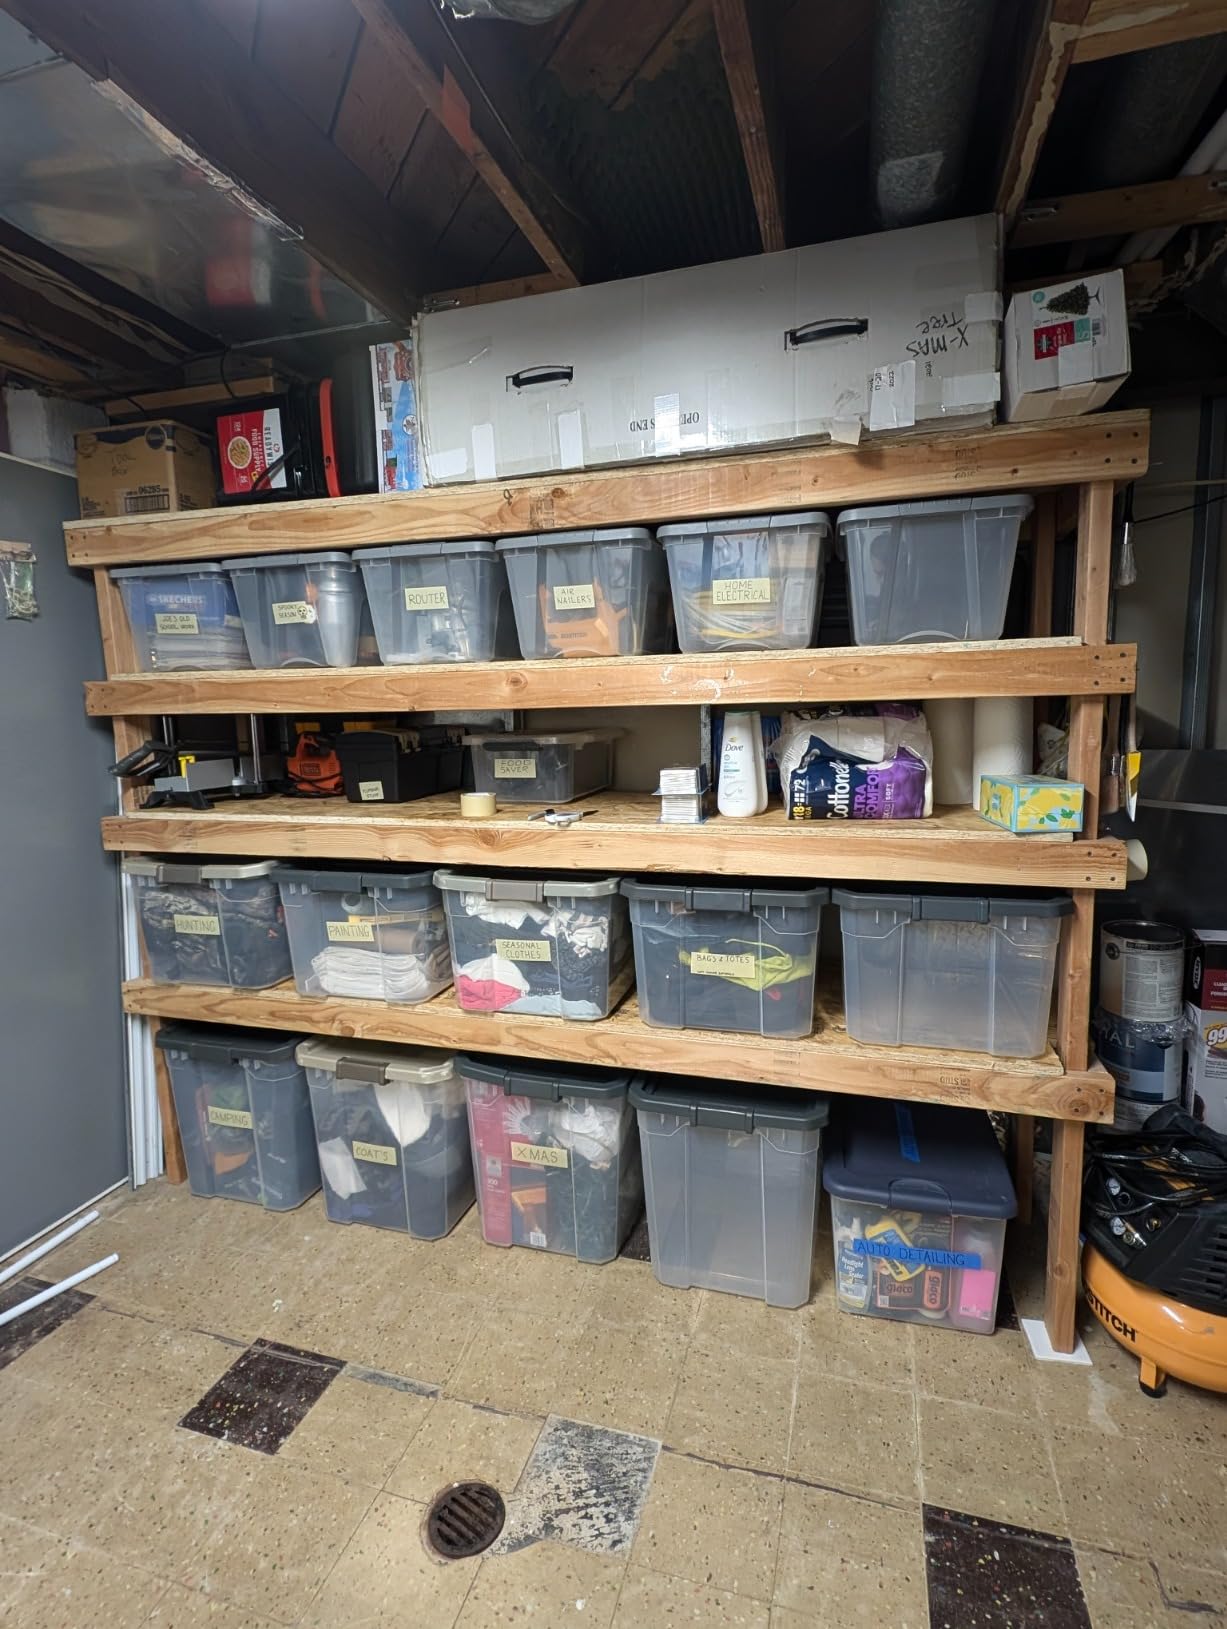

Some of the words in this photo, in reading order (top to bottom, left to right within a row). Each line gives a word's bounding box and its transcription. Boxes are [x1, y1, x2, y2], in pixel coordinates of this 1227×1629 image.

[916, 312, 964, 334] Tree
[905, 324, 969, 358] X-MAS
[679, 411, 700, 426] OPE
[629, 419, 649, 432] END
[251, 428, 259, 446] FOOD
[252, 446, 262, 472] SUPPLY
[561, 587, 575, 596] AIR
[724, 580, 753, 590] HOME
[408, 593, 446, 606] ROUTER
[557, 595, 592, 605] NAILERS
[715, 589, 769, 602] ELECTRICAL
[725, 743, 744, 752] Dove
[500, 759, 531, 767] FOOD
[500, 765, 529, 774] SAVER
[794, 779, 806, 791] 72
[175, 919, 216, 933] HUNTING
[328, 924, 370, 937] PAINTING
[501, 941, 542, 950] SEASONAL
[505, 949, 541, 960] CLOTHES
[696, 954, 717, 963] BAGS
[726, 955, 750, 964] TOTES
[210, 1110, 249, 1126] CAMPING
[517, 1146, 559, 1164] XMAS
[857, 1241, 890, 1257] AUTO
[899, 1247, 965, 1266] DETAILING
[886, 1283, 913, 1294] glaco
[929, 1275, 940, 1305] glaco
